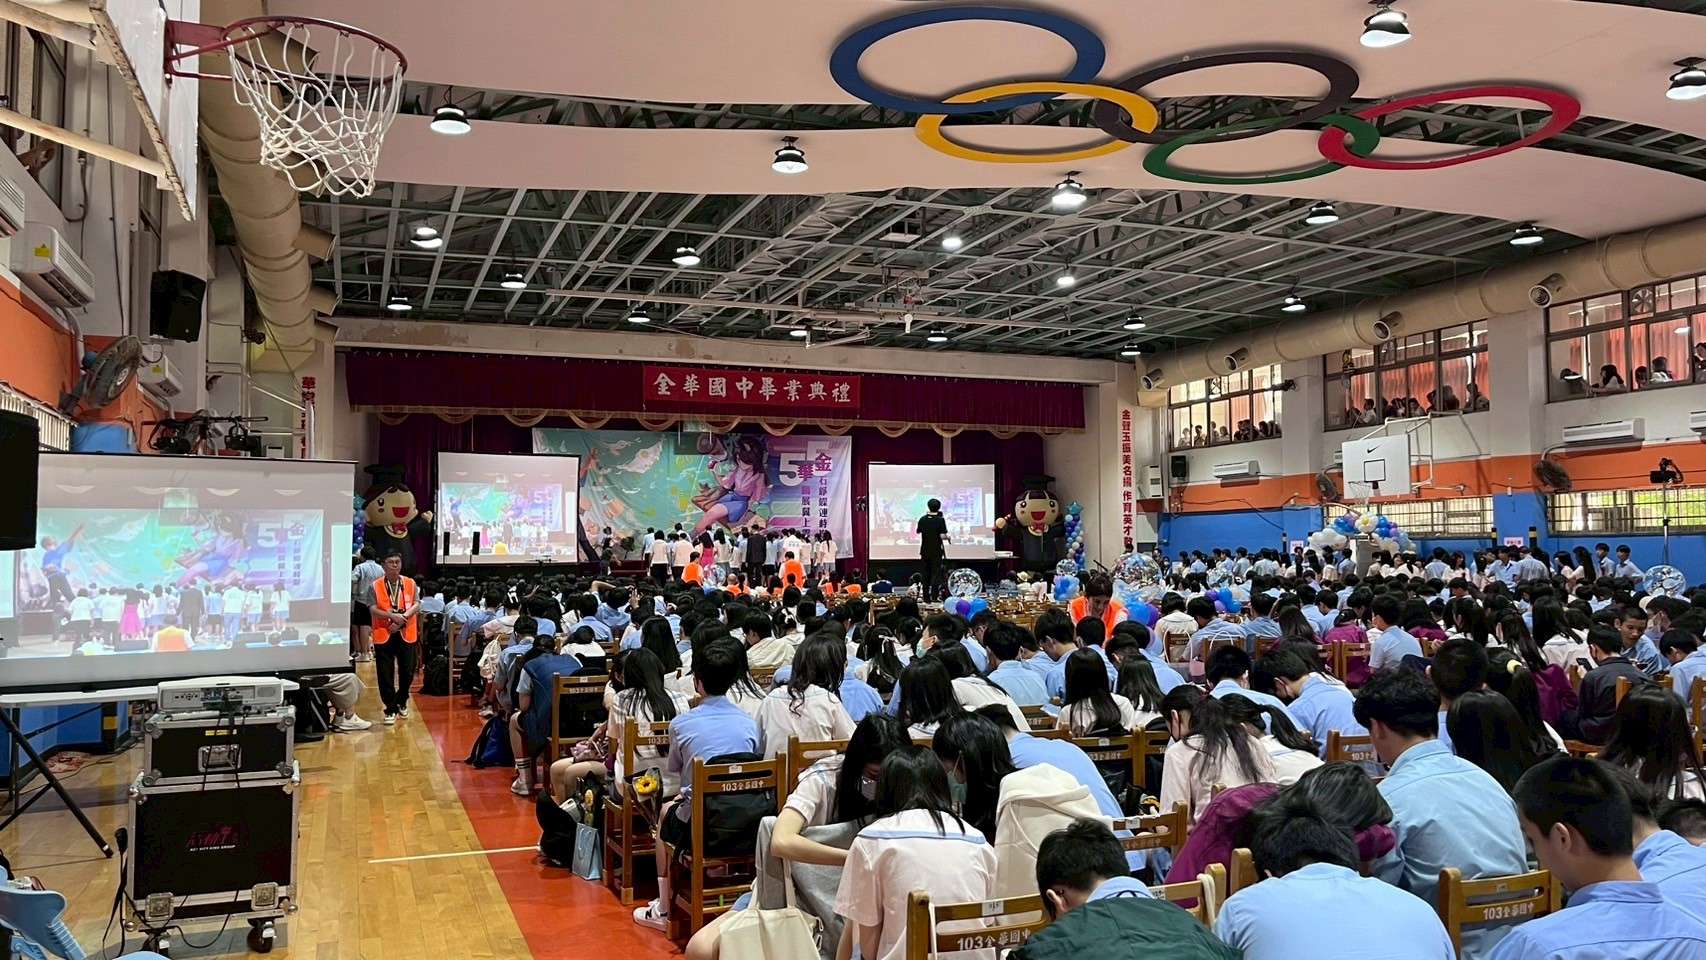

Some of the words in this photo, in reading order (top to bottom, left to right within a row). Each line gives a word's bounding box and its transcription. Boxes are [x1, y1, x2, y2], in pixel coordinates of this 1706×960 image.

[653, 372, 851, 402] 金華國中畢業典禮
[957, 928, 1031, 951] 103金華國中
